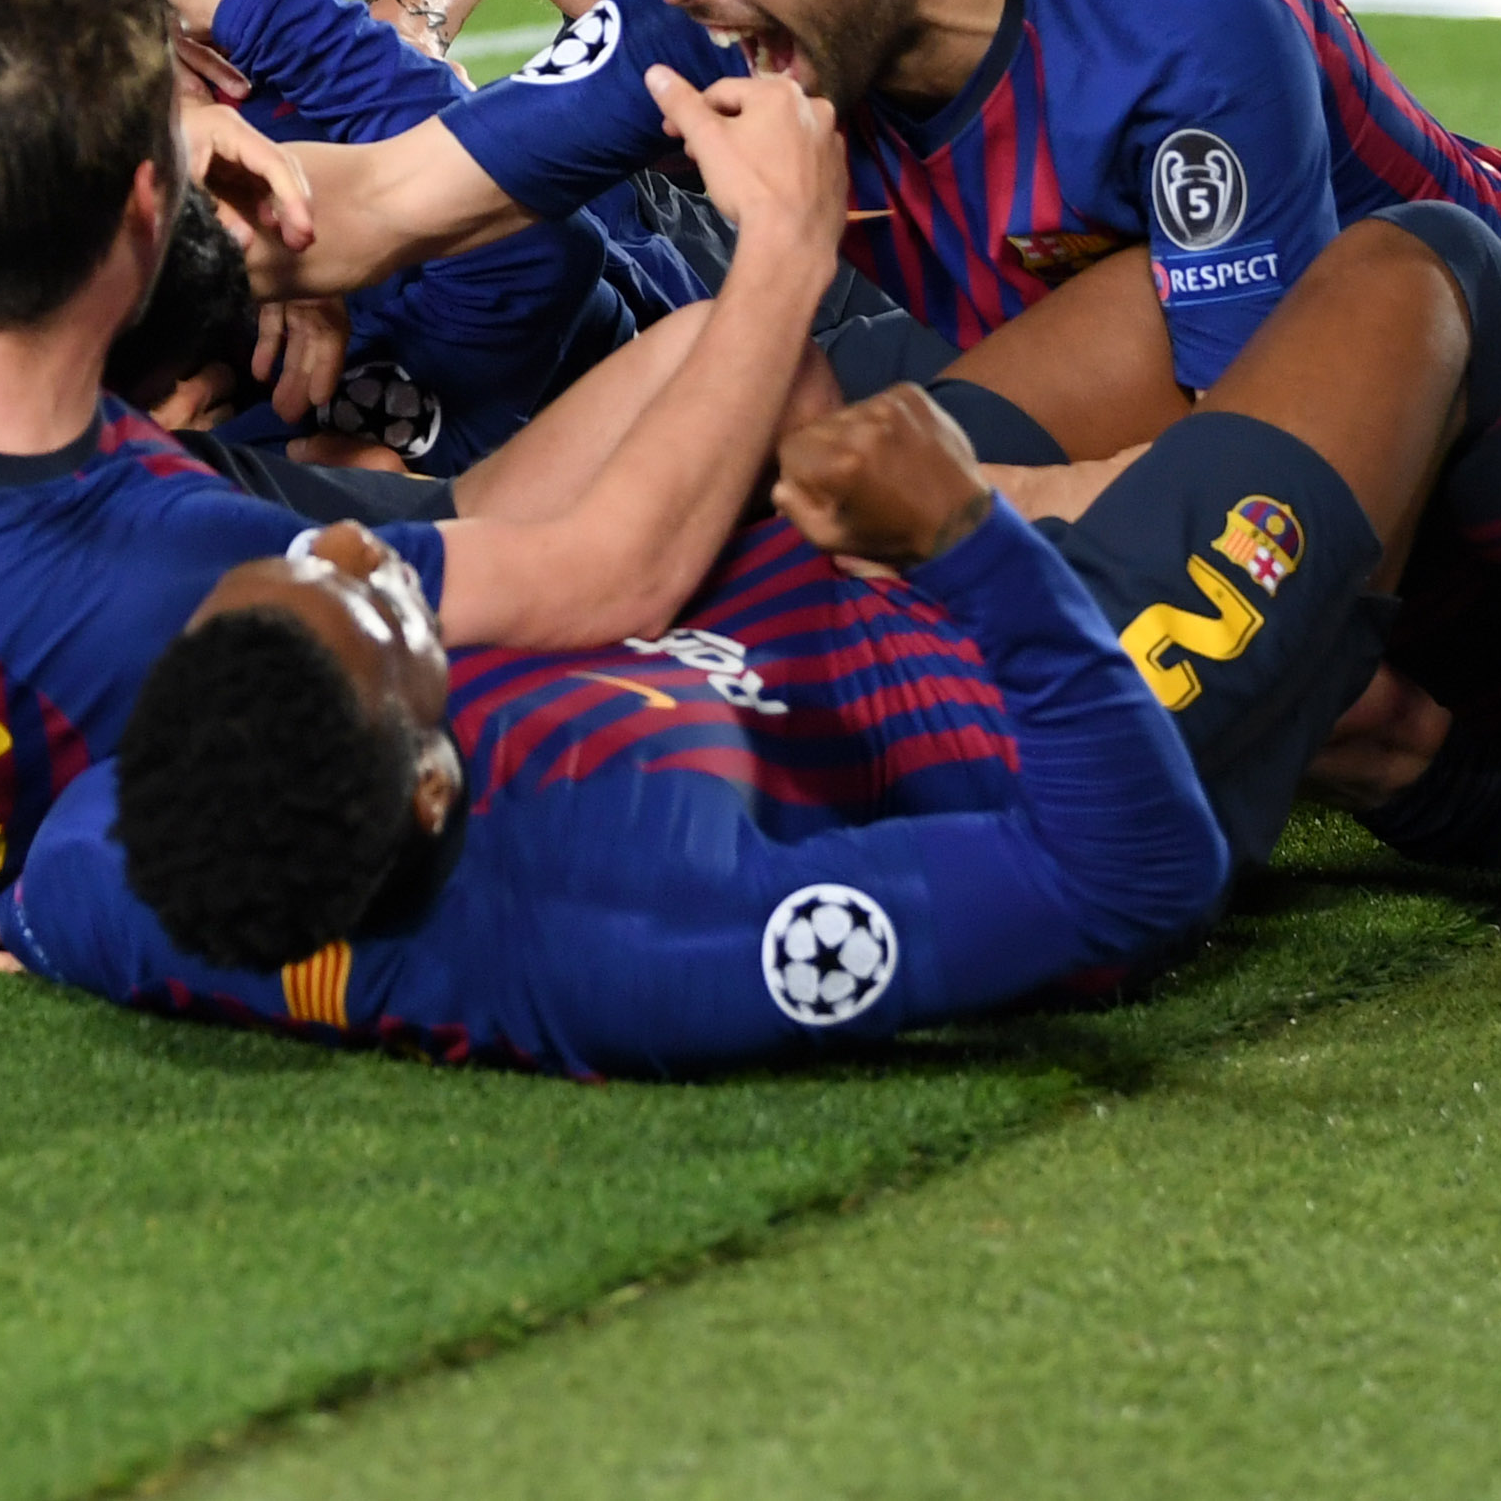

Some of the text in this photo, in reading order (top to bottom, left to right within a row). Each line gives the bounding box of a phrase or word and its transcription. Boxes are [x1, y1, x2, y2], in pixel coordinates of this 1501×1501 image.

[1188, 189, 1210, 220] 5
[1169, 253, 1279, 294] RESPECT
[1118, 553, 1265, 711] 2
